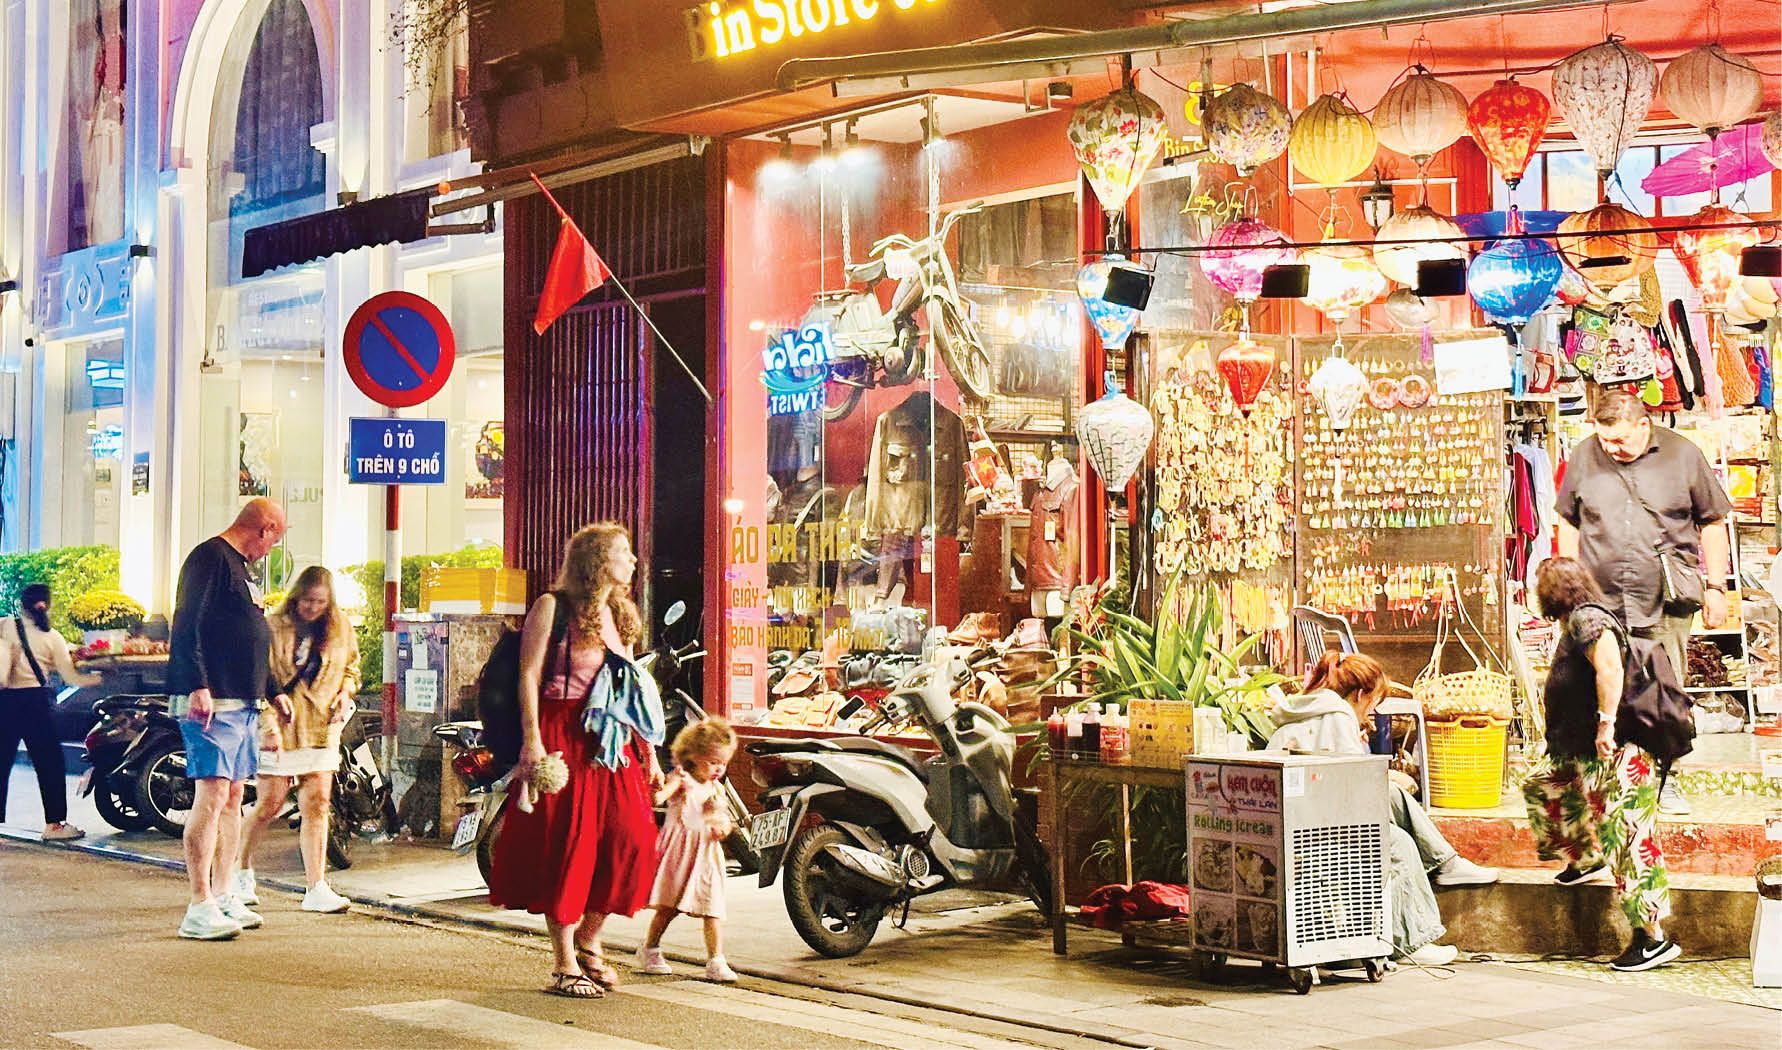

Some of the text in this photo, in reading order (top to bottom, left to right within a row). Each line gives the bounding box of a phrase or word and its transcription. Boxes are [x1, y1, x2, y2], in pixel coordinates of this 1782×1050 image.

[383, 428, 415, 448] Ô TÔ
[356, 452, 440, 474] TRÊN 9 CHỖ
[731, 516, 759, 564] ÁO
[768, 523, 797, 562] DA
